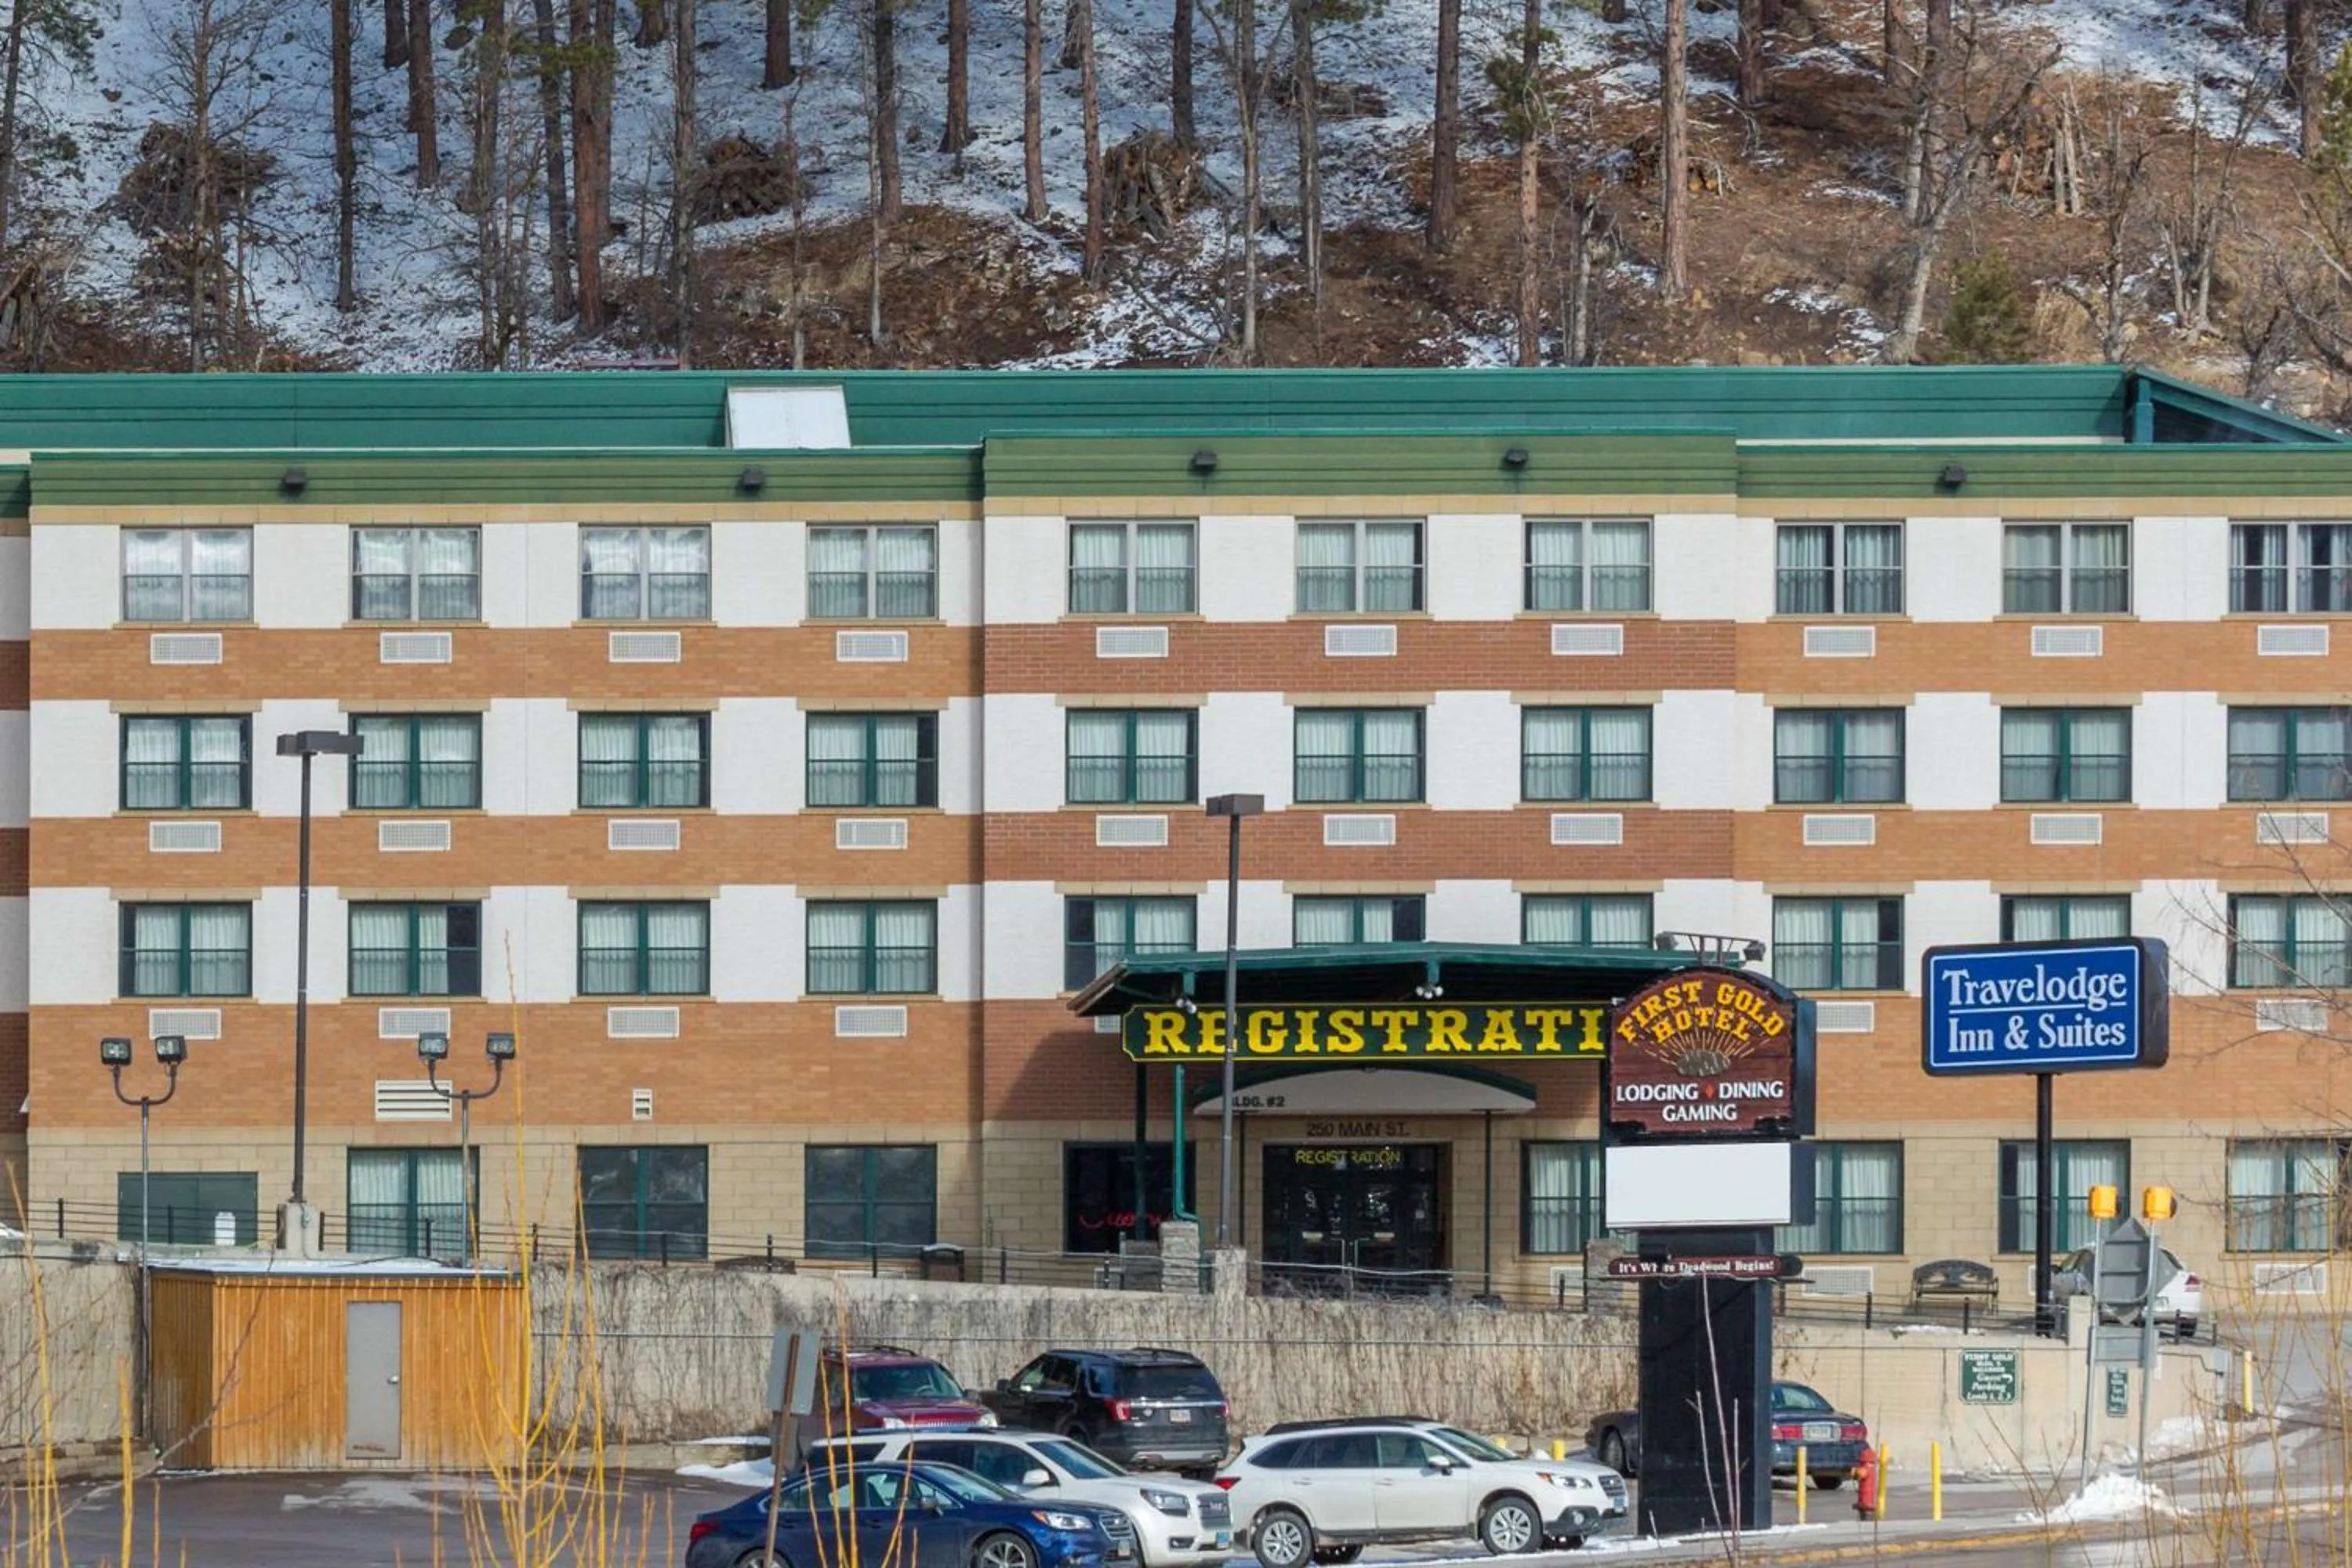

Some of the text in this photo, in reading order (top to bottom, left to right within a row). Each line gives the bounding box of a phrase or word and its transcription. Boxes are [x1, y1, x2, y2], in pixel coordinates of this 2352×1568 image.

[1941, 964, 2128, 1011] Travelodge
[1144, 1008, 1604, 1053] REGISTRATI
[1617, 980, 1784, 1044] FIRST GOLD
[1651, 1007, 1751, 1044] HOTEL
[1947, 1013, 2126, 1053] Inn & Suites
[1232, 1096, 1285, 1107] LDG. #2
[1616, 1080, 1784, 1102] LODGING DINING
[1307, 1121, 1410, 1136] 250 MAIN ST.
[1662, 1104, 1737, 1122] GAMING
